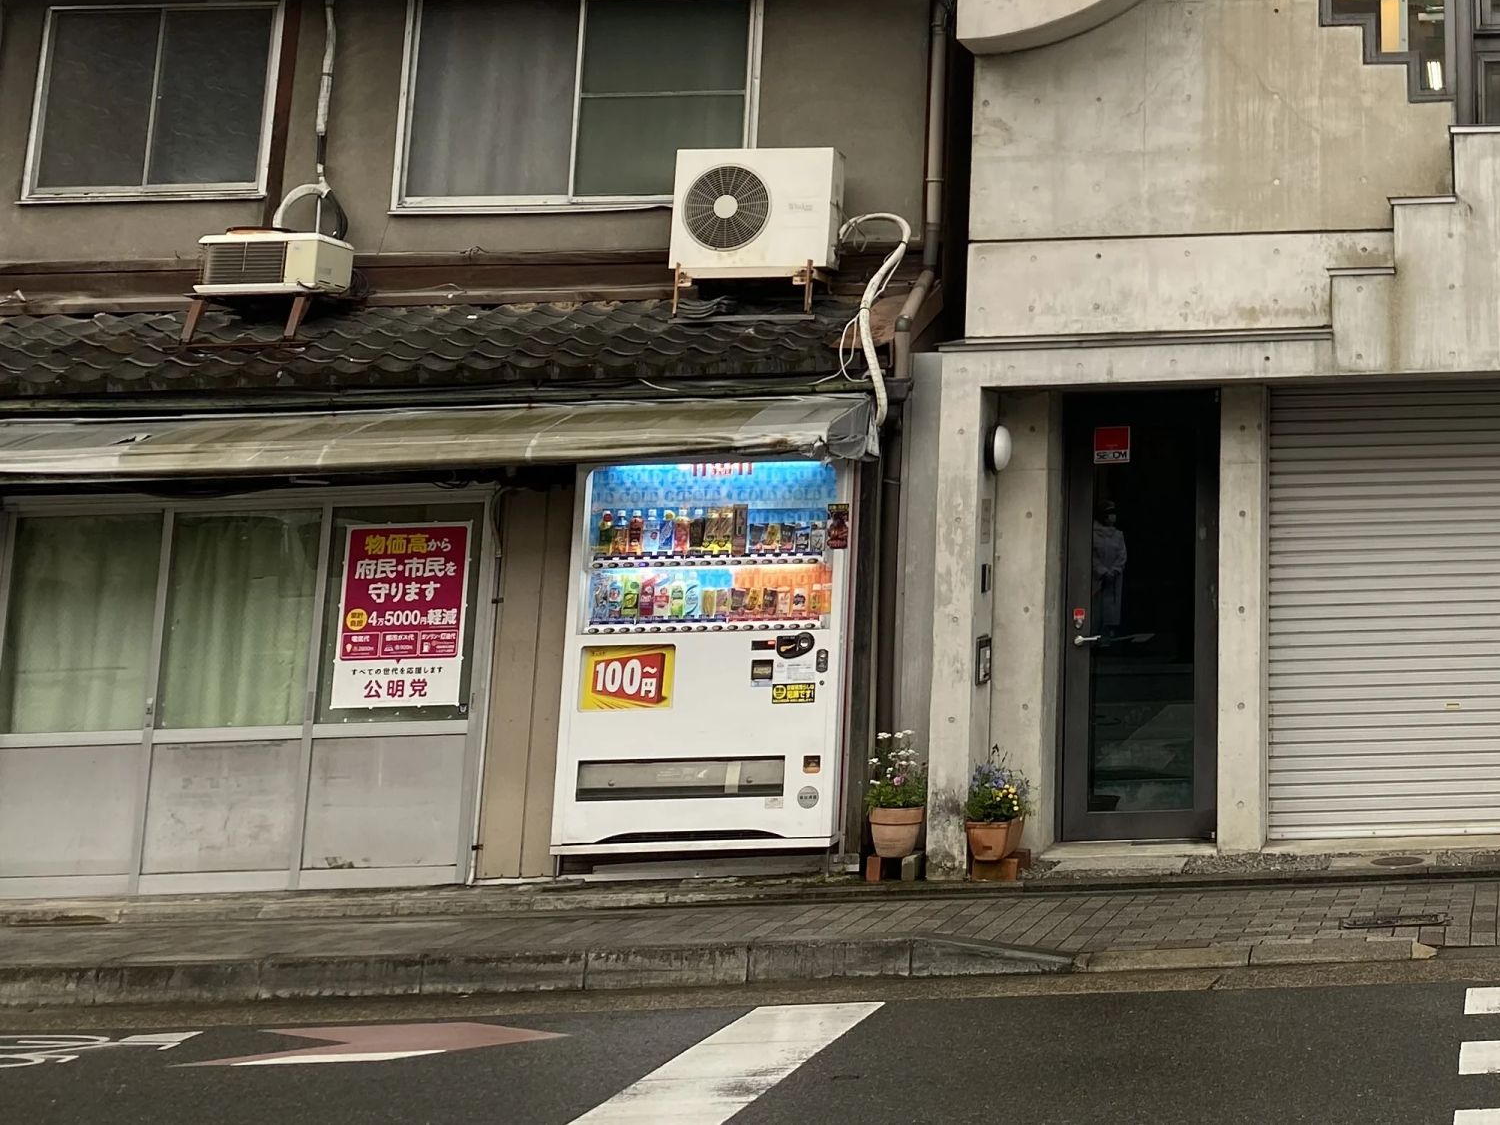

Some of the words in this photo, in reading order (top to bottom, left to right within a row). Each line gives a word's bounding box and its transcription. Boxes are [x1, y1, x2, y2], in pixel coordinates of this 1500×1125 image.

[1096, 450, 1128, 460] SEOM
[364, 533, 451, 555] 物価高から
[355, 557, 457, 579] 府民・市民を
[368, 581, 440, 603] 守ります
[363, 678, 428, 699] 公明党
